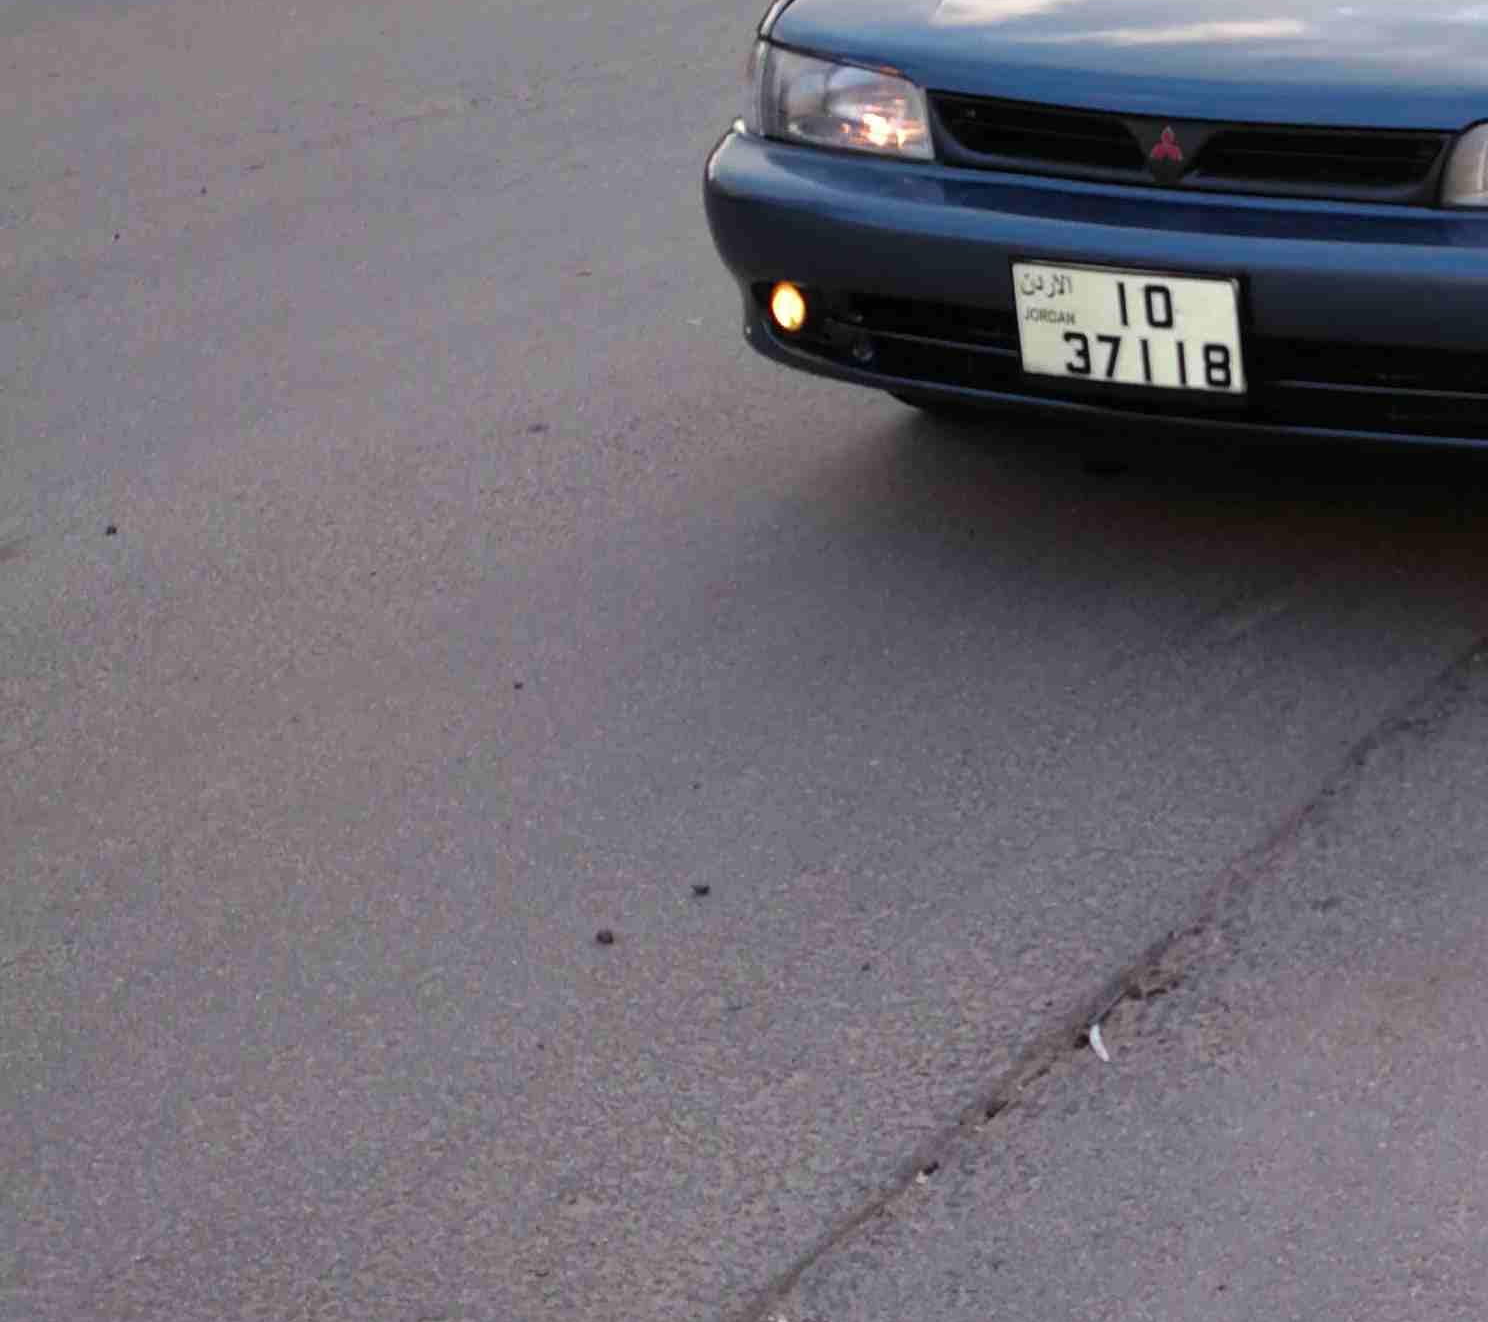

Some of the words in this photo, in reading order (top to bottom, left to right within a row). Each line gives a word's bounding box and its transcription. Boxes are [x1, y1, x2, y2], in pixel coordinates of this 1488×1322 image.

[1024, 306, 1077, 325] JORDAN
[1117, 280, 1174, 328] 10
[1063, 331, 1232, 388] 37118
